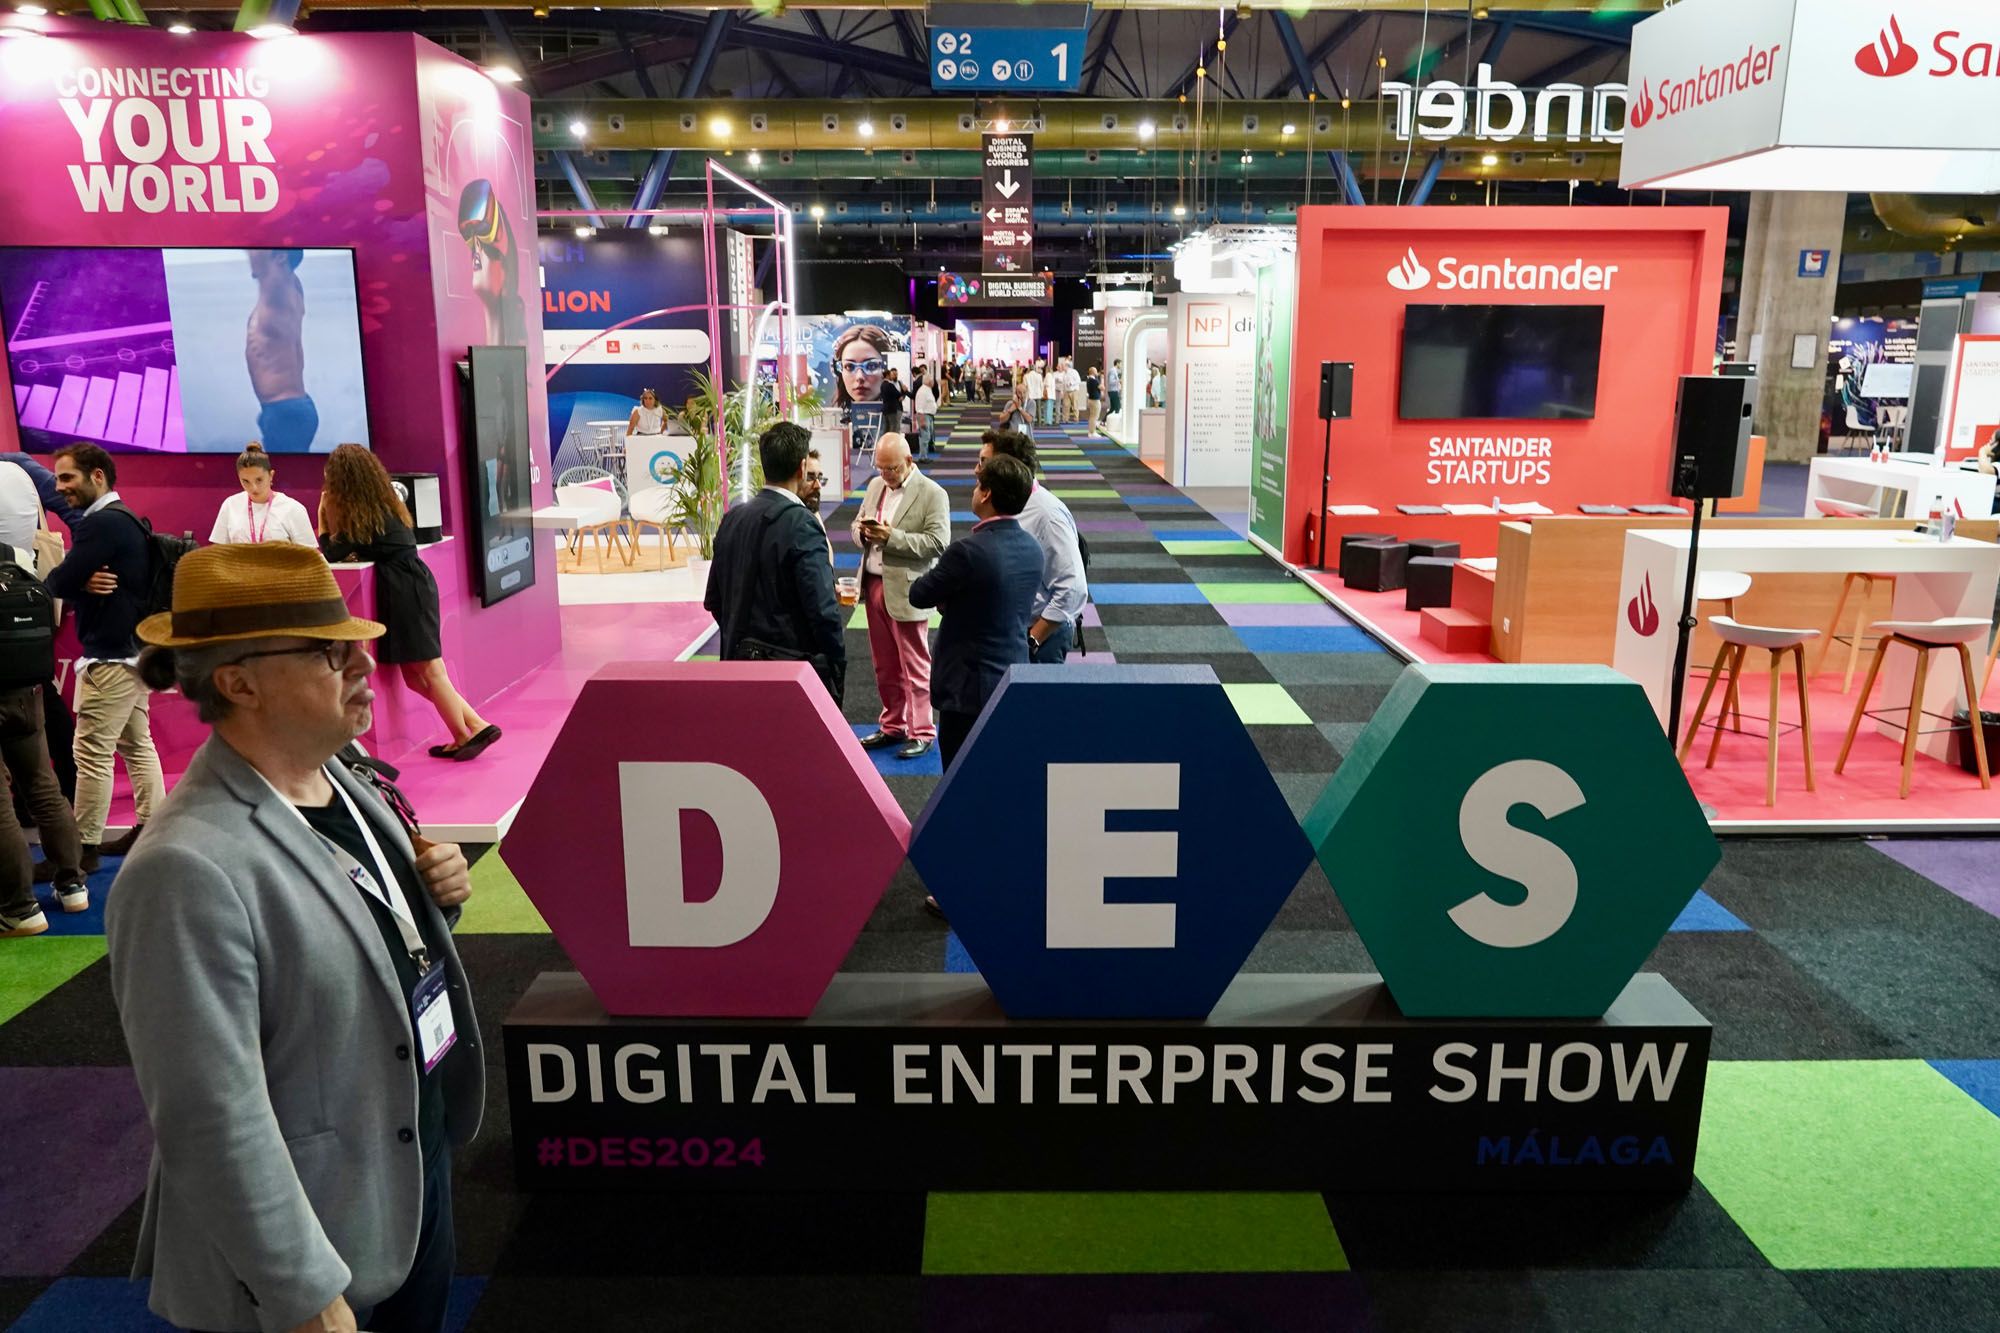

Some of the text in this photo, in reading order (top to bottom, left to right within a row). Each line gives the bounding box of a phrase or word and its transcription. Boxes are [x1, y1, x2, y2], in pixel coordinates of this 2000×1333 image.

[959, 33, 972, 55] 2
[1929, 30, 2000, 78] Sa
[1051, 42, 1068, 82] 1
[55, 67, 270, 98] CONNECTING
[1656, 43, 1781, 121] Santander
[57, 97, 277, 165] YOUR
[67, 164, 280, 213] WORLD
[729, 238, 739, 333] FRENCH
[987, 282, 1045, 290] DIGITAL BUSINESS
[1437, 257, 1618, 290] Santander
[1194, 317, 1222, 333] NP
[1234, 316, 1255, 333] di
[1428, 437, 1552, 457] SANTANDER
[1426, 460, 1551, 485] STARTUPS
[527, 1041, 1689, 1104] DIGITAL ENTERPRISE SHOW
[537, 1136, 766, 1167] #DES2024
[1477, 1128, 1674, 1165] MÁLAGA
